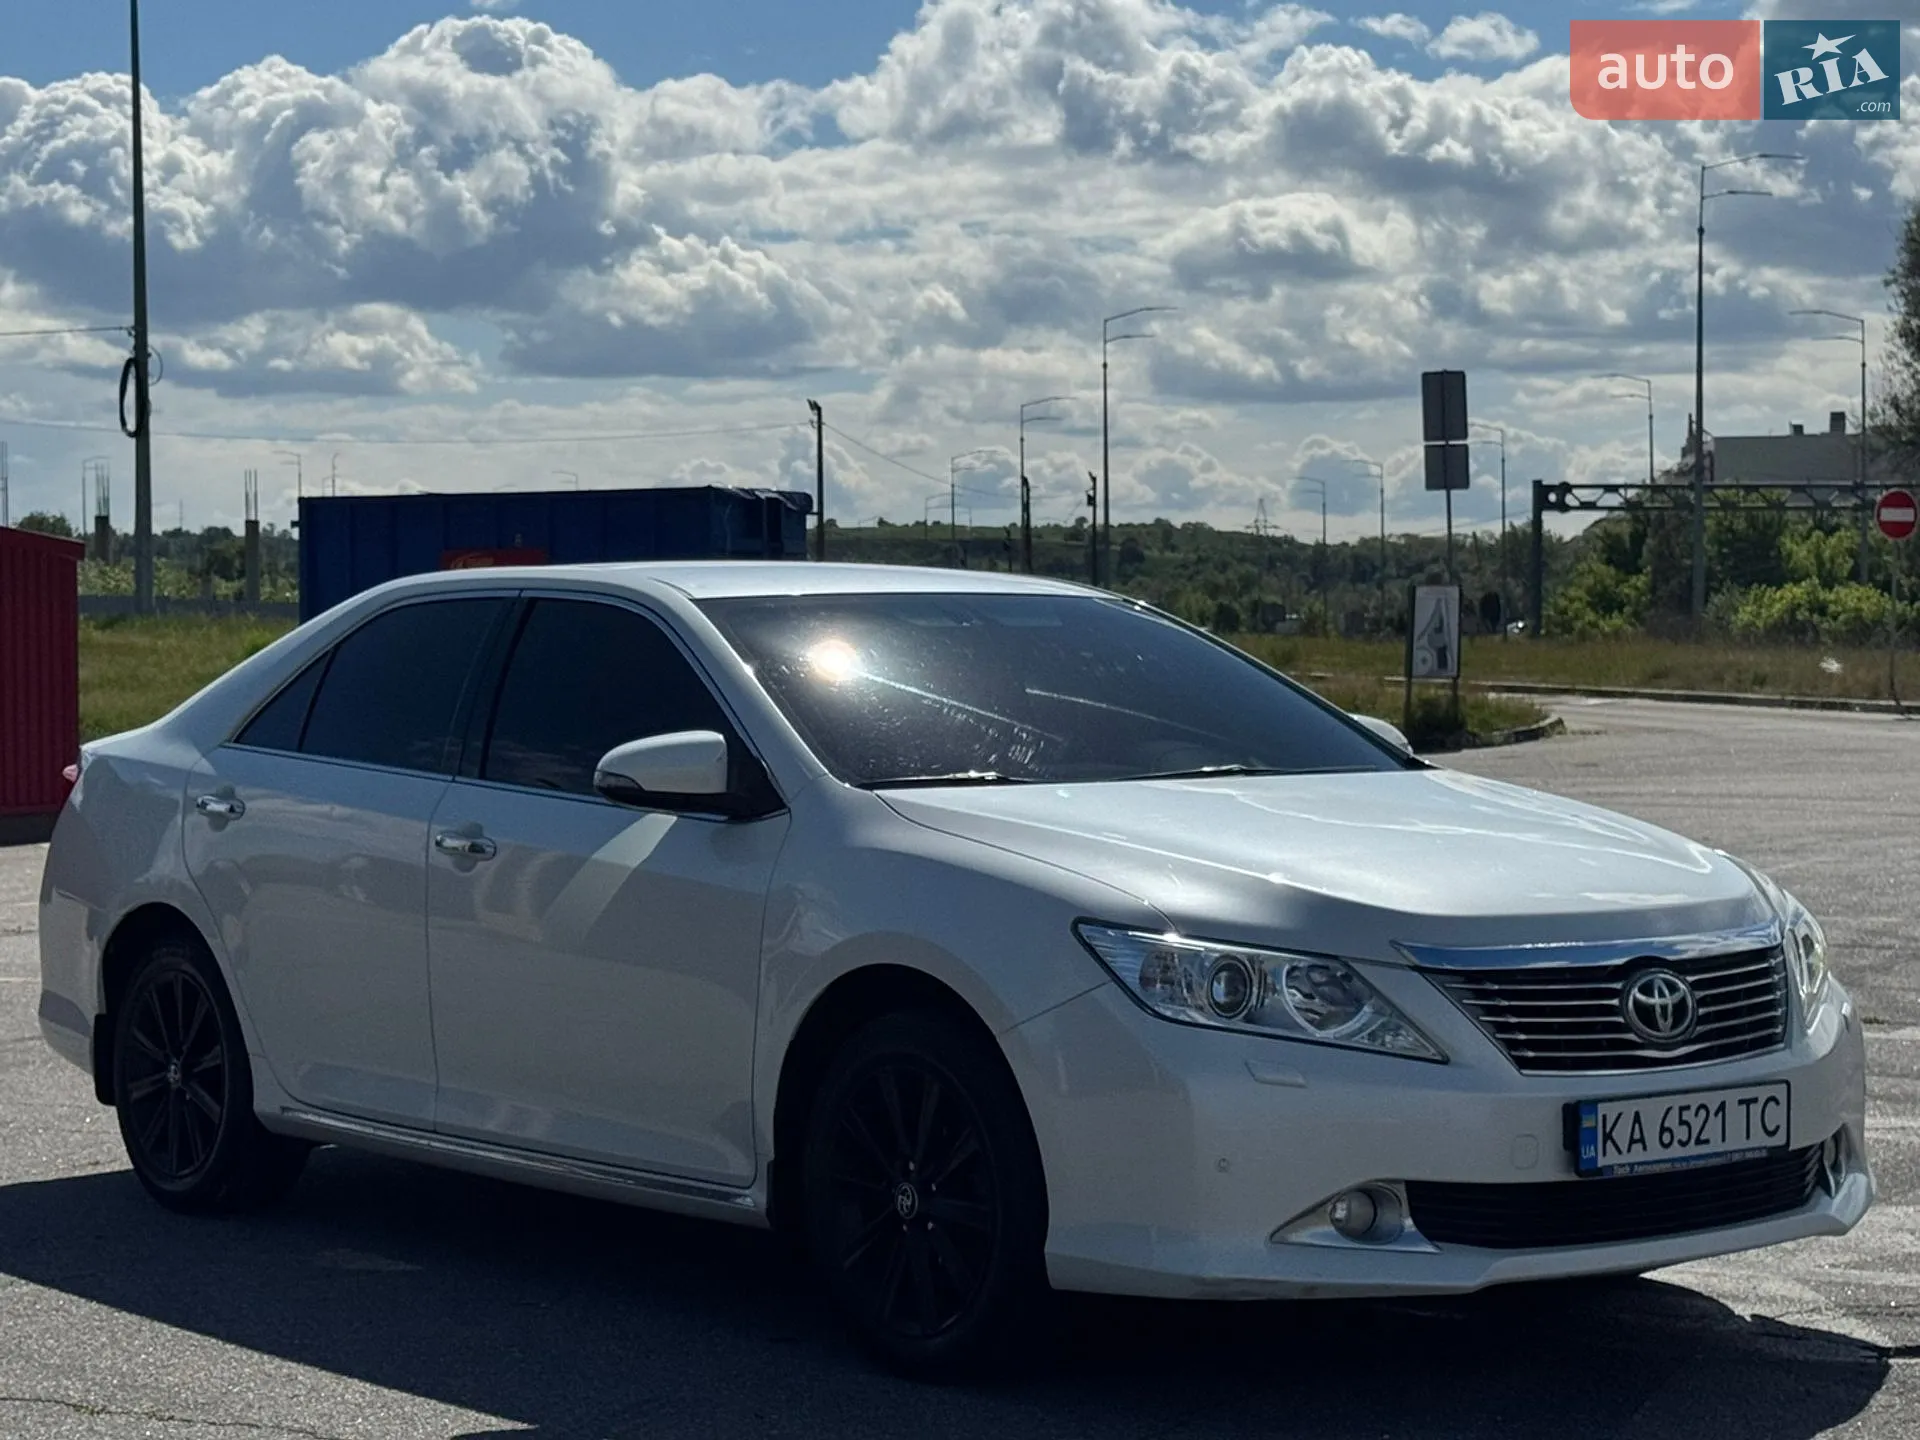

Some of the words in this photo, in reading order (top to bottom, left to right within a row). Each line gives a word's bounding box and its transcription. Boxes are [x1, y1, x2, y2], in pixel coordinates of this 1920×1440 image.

[1602, 1110, 1648, 1157] KA
[1658, 1100, 1727, 1149] 6521
[1737, 1096, 1781, 1141] TC
[1581, 1145, 1596, 1159] UA
